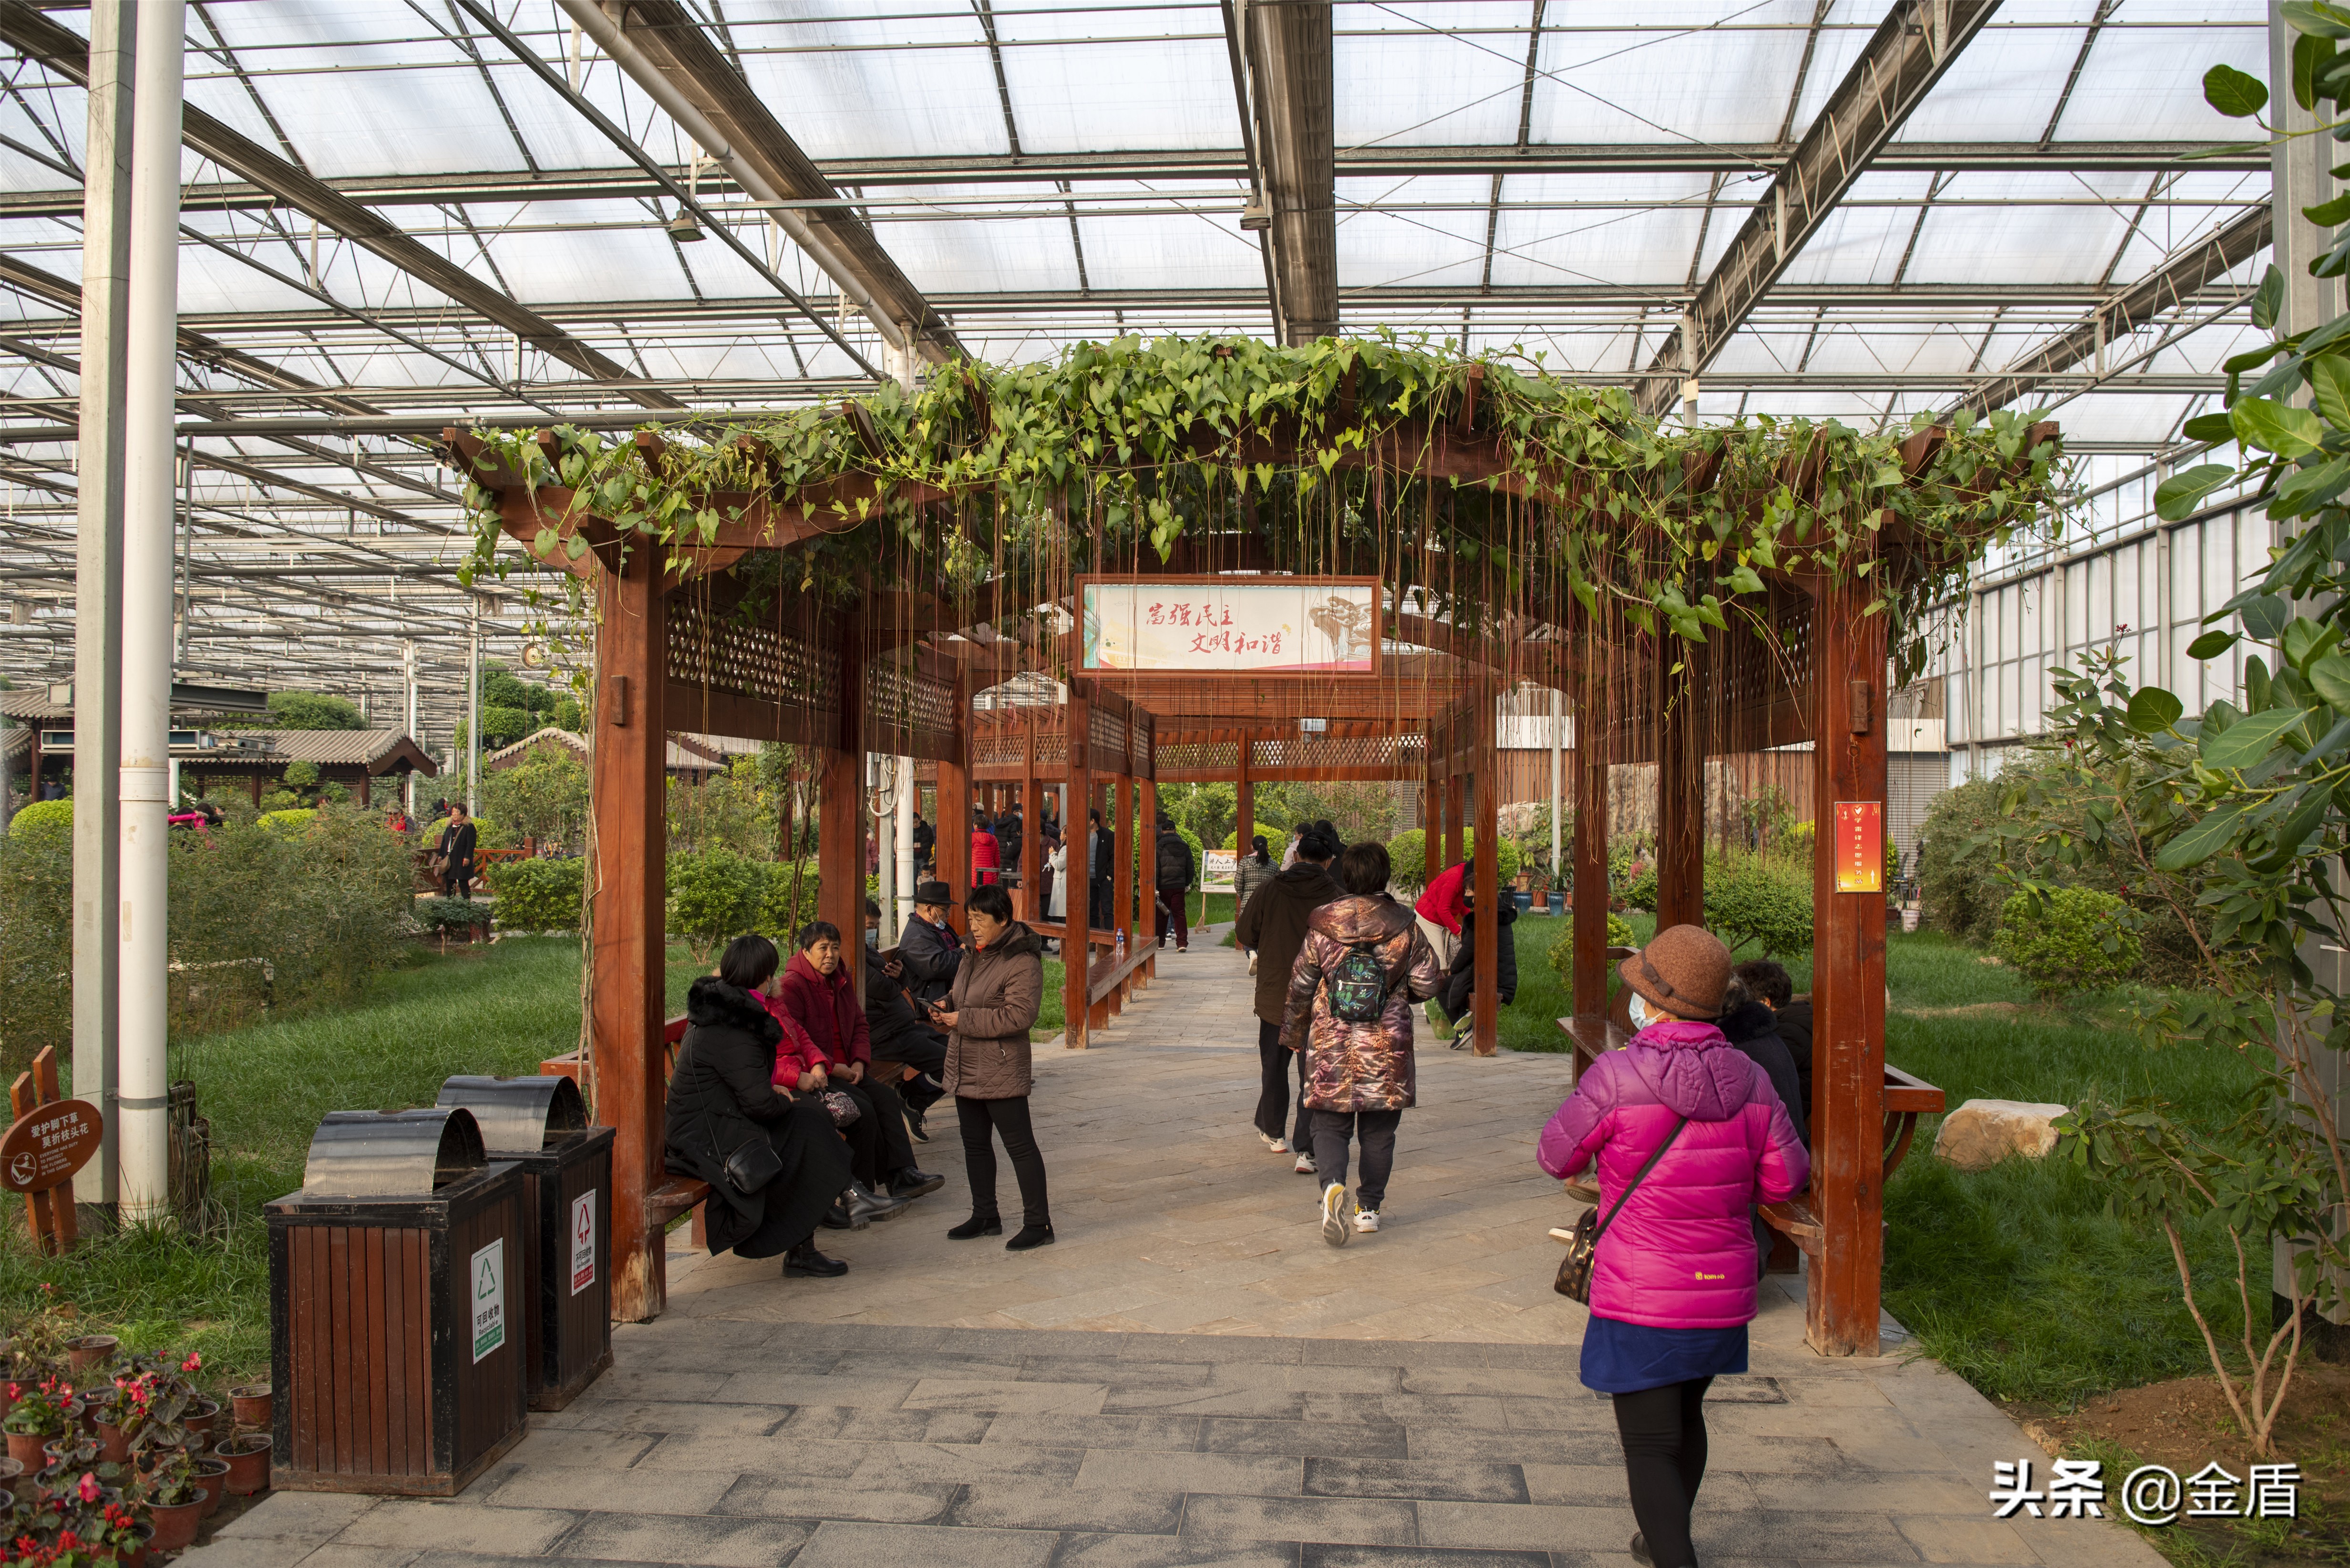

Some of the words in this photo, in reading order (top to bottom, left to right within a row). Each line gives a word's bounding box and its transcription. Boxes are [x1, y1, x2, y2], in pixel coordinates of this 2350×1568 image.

[1146, 602, 1234, 626] 富强民主
[1188, 630, 1282, 654] 文明和谐
[1854, 817, 1863, 884] 学雷锋志愿服务站
[31, 1112, 79, 1138] 爱护脚下草
[42, 1123, 89, 1148] 莫折枝头花
[40, 1148, 59, 1158] EVERYONE
[47, 1153, 63, 1162] PROTECT
[50, 1157, 67, 1166] FLOWERS
[56, 1162, 72, 1170] GARDEN
[576, 1246, 592, 1263] 不可回收物
[476, 1303, 500, 1327] 可回收物
[478, 1319, 498, 1336] Recyclable
